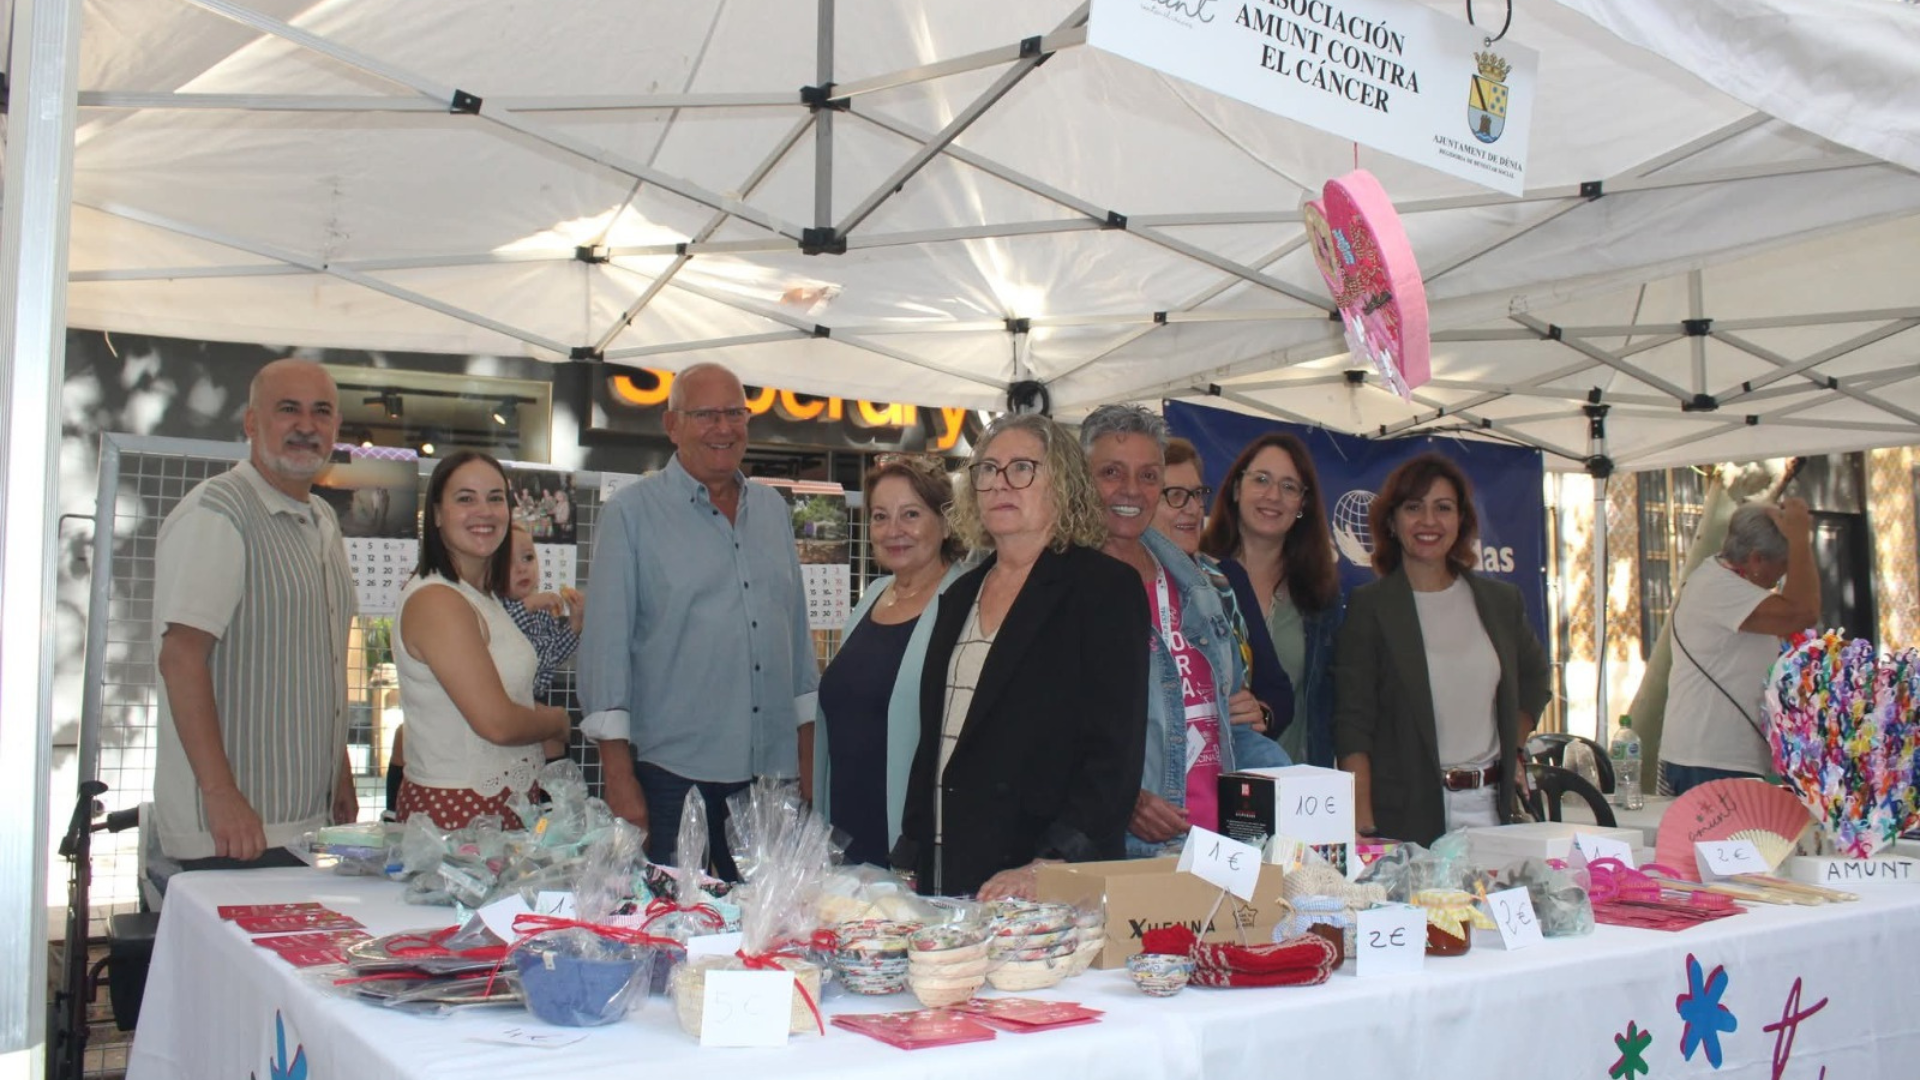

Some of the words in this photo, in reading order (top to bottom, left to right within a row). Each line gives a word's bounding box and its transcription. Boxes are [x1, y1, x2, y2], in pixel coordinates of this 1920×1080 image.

[1259, 0, 1405, 57] OCIACIÓN
[1235, 3, 1323, 55] AMUNT
[1327, 39, 1420, 94] CONTRA
[1259, 44, 1291, 76] EL
[1296, 59, 1389, 113] CÁNCER
[1432, 134, 1486, 160] AJUNTAMENT
[1487, 152, 1498, 164] DE
[367, 541, 374, 550] 5
[383, 542, 390, 550] 6
[367, 554, 375, 562] 12
[383, 554, 391, 562] 13
[367, 566, 375, 574] 19
[383, 567, 393, 575] 20
[366, 579, 376, 587] 26
[382, 579, 392, 587] 27
[1295, 795, 1318, 816] 10
[1324, 796, 1336, 814] €
[1227, 851, 1244, 871] €
[1827, 861, 1913, 881] AMUNT
